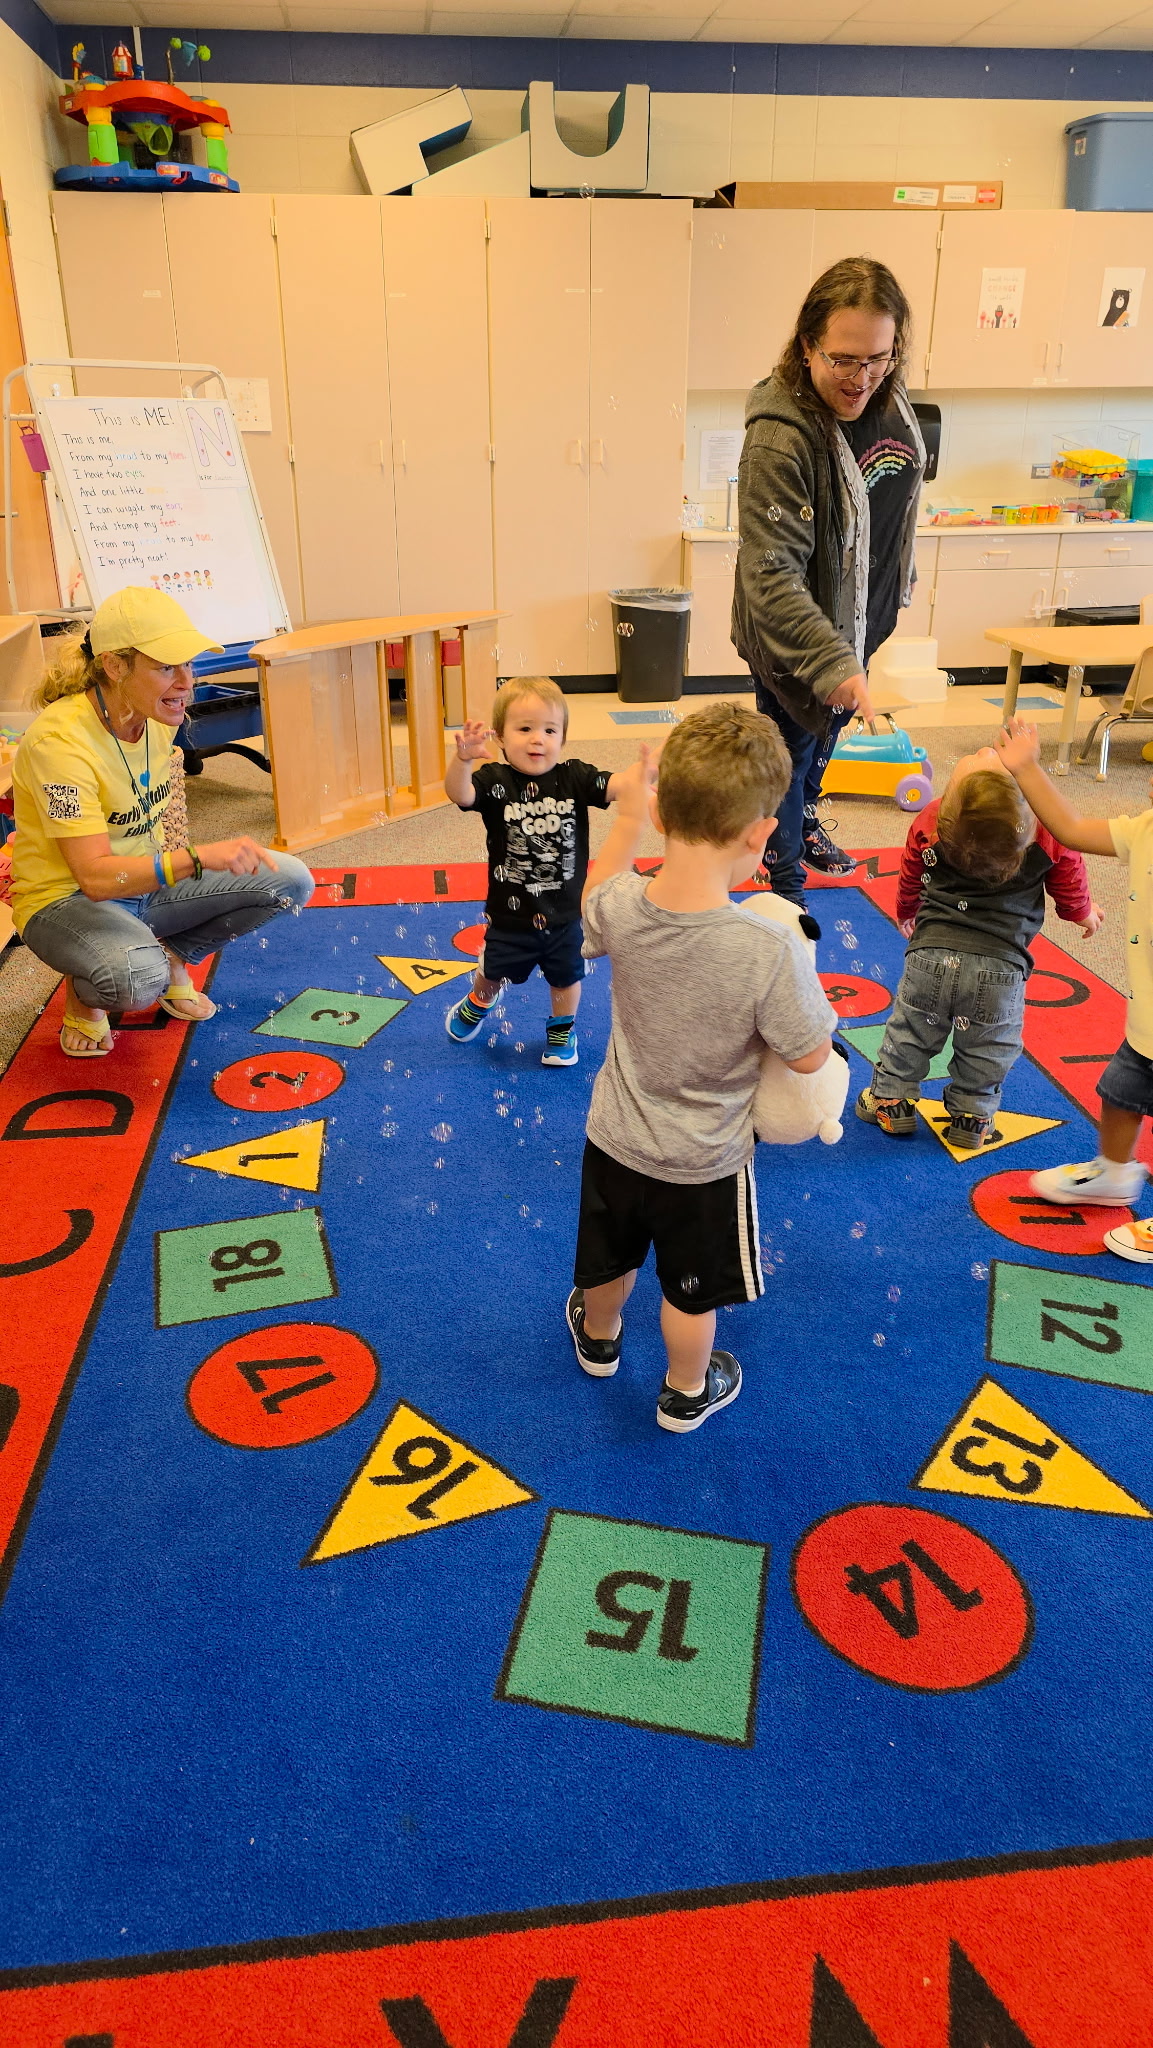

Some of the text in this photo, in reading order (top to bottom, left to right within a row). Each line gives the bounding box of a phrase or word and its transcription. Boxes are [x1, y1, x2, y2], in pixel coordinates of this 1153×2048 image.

[88, 407, 174, 426] This is ME!
[61, 433, 82, 444] This
[87, 436, 94, 444] is
[186, 407, 236, 467] N
[69, 452, 94, 461] From
[98, 454, 113, 467] my
[140, 450, 151, 460] to
[155, 454, 168, 464] my
[72, 468, 82, 479] I
[84, 469, 104, 479] have
[106, 469, 122, 478] two
[80, 486, 96, 497] And
[102, 488, 117, 496] one
[119, 486, 144, 495] little
[83, 504, 92, 514] I
[97, 506, 112, 514] can
[115, 504, 145, 515] wiggle
[150, 504, 164, 516] my
[89, 522, 108, 531] And
[114, 521, 139, 531] stomp
[144, 522, 158, 533] my
[93, 539, 117, 549] From
[122, 540, 136, 552] my
[166, 534, 176, 543] to
[180, 536, 193, 546] my
[97, 552, 169, 568] I'm pretty neat!
[107, 805, 140, 826] Early
[504, 796, 575, 822] ARMOR OF
[521, 814, 561, 836] GOD
[410, 964, 448, 981] 4
[310, 1009, 361, 1026] 3
[250, 1071, 309, 1089] 2
[0, 1088, 135, 1142] D
[237, 1152, 299, 1168] 1
[210, 1238, 286, 1293] 18
[1040, 1298, 1124, 1354] 12
[235, 1355, 337, 1415] 17
[949, 1417, 1060, 1496] 13
[368, 1435, 480, 1521] 16
[843, 1539, 984, 1640] 14
[583, 1569, 700, 1664] 15
